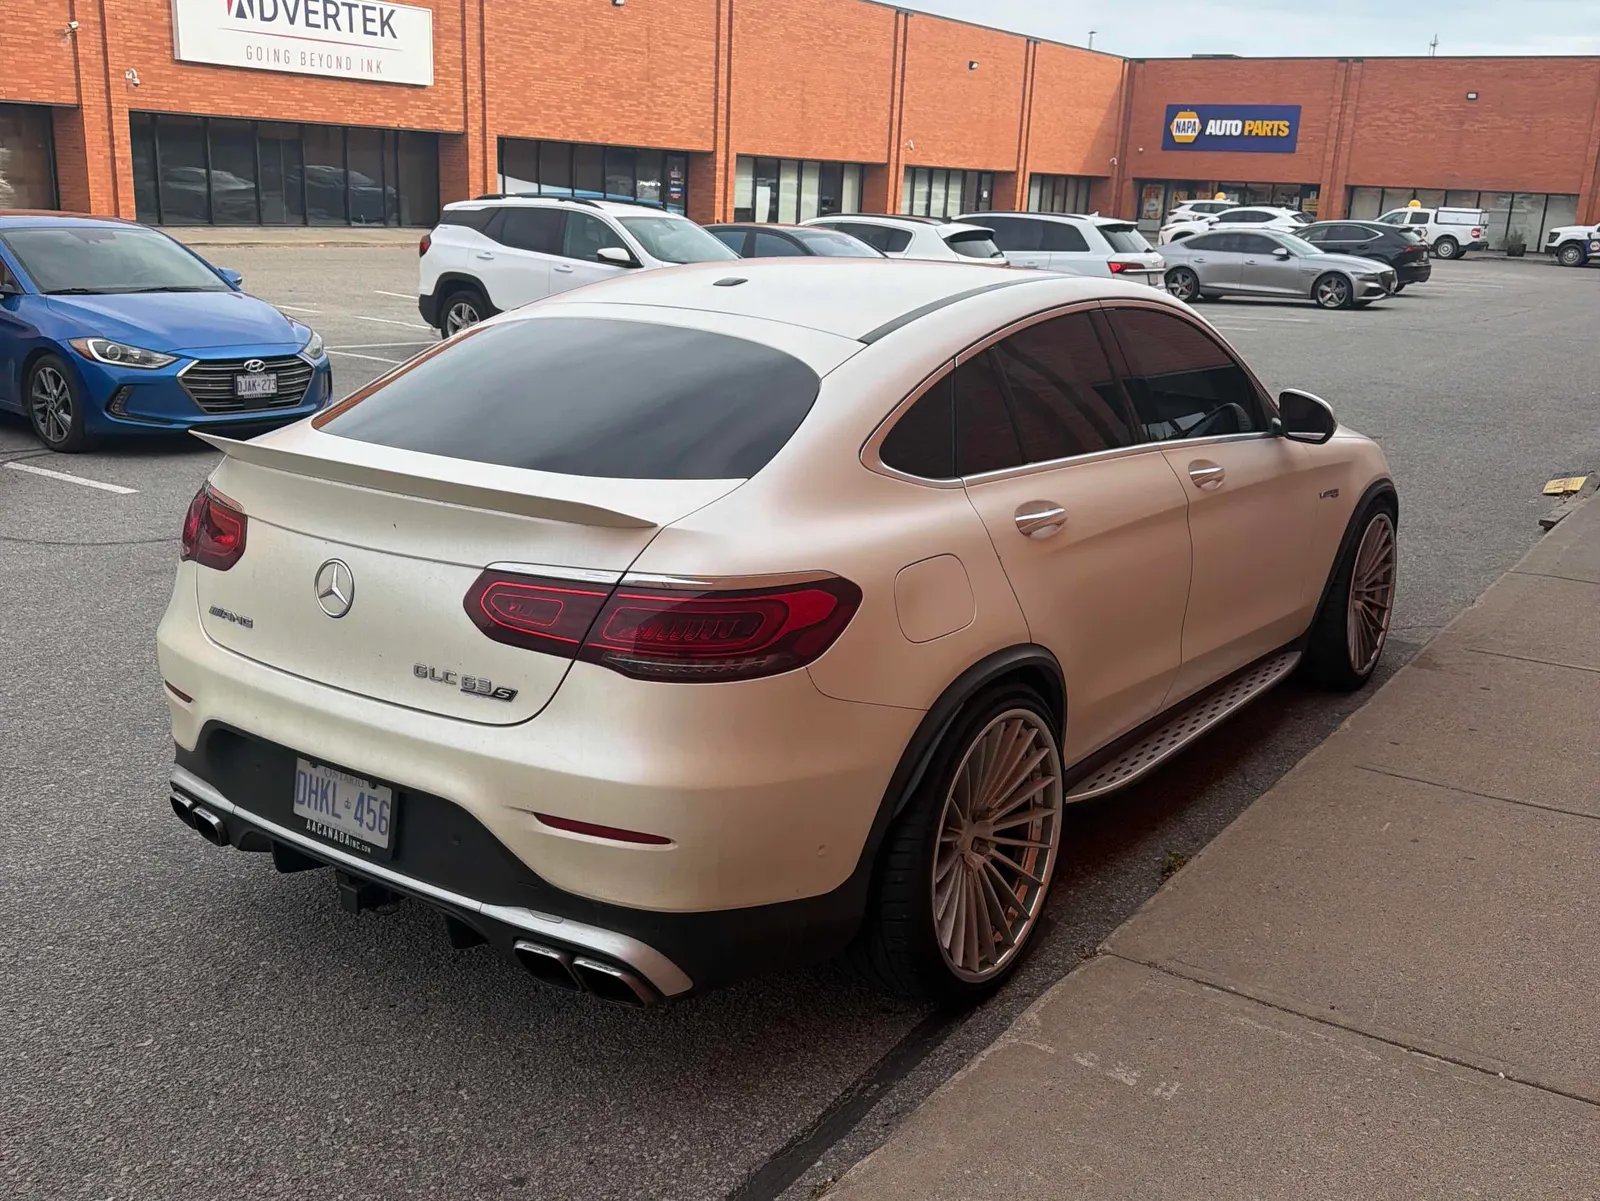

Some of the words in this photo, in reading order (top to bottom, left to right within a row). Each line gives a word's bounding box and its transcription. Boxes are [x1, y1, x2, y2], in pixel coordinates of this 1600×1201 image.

[246, 45, 291, 65] GOING
[300, 52, 352, 71] BEYOND
[360, 59, 383, 75] INK
[1174, 120, 1197, 134] NAPA
[1205, 119, 1243, 136] AUTO
[1243, 120, 1290, 137] PARTS
[237, 379, 256, 393] DJAK
[262, 378, 277, 391] 273
[413, 663, 457, 685] GLC
[461, 674, 492, 694] 63
[295, 769, 342, 820] DHKL
[353, 791, 390, 836] 456
